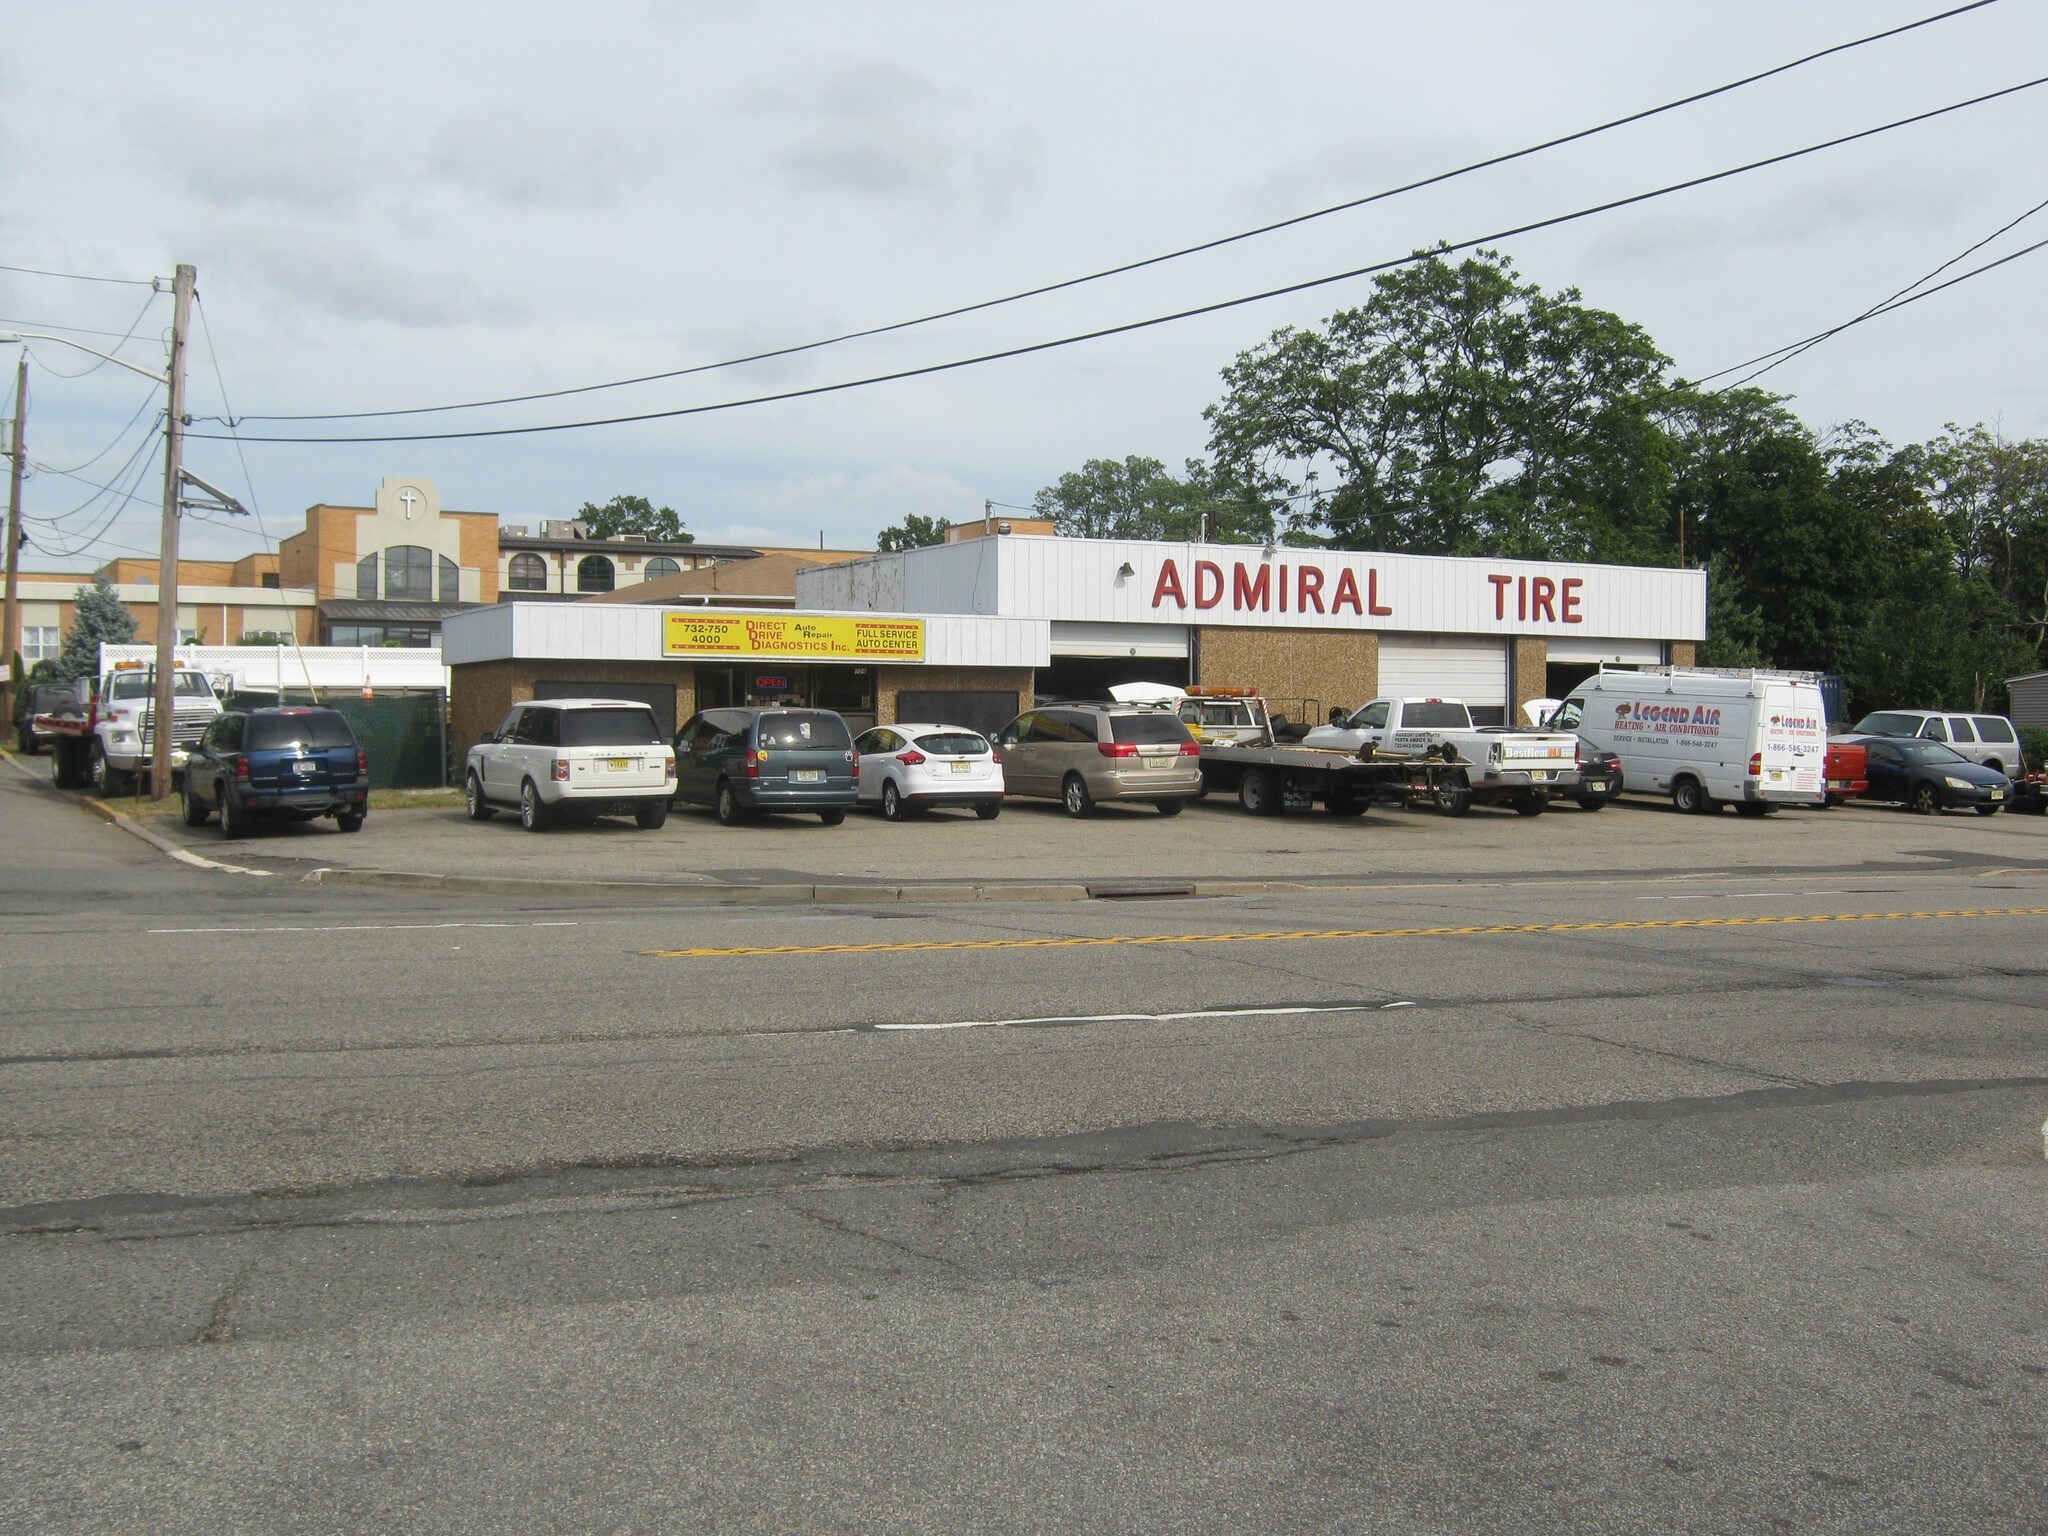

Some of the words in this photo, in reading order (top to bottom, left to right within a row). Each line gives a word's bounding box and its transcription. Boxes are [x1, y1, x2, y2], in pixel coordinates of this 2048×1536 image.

[1151, 558, 1392, 616] ADMIRAL
[1488, 574, 1583, 624] TIRE
[683, 624, 728, 633] 732-750
[745, 620, 787, 631] DIRECT
[691, 635, 721, 643] 4000
[748, 630, 783, 640] DRIVE
[803, 631, 833, 639] Repair
[856, 629, 878, 638] FULL
[880, 630, 918, 639] SERVICE
[751, 640, 828, 651] DIAGNOSTICS
[831, 641, 850, 652] Inc.
[856, 639, 881, 648] AUTO
[882, 640, 918, 649] CENTER
[756, 678, 785, 687] OPEN
[1633, 702, 1690, 724] LEGEND
[1691, 705, 1721, 725] AIR
[1614, 721, 1644, 731] HEATING
[1654, 723, 1667, 732] AIR
[1669, 724, 1720, 736] CONDITIONING
